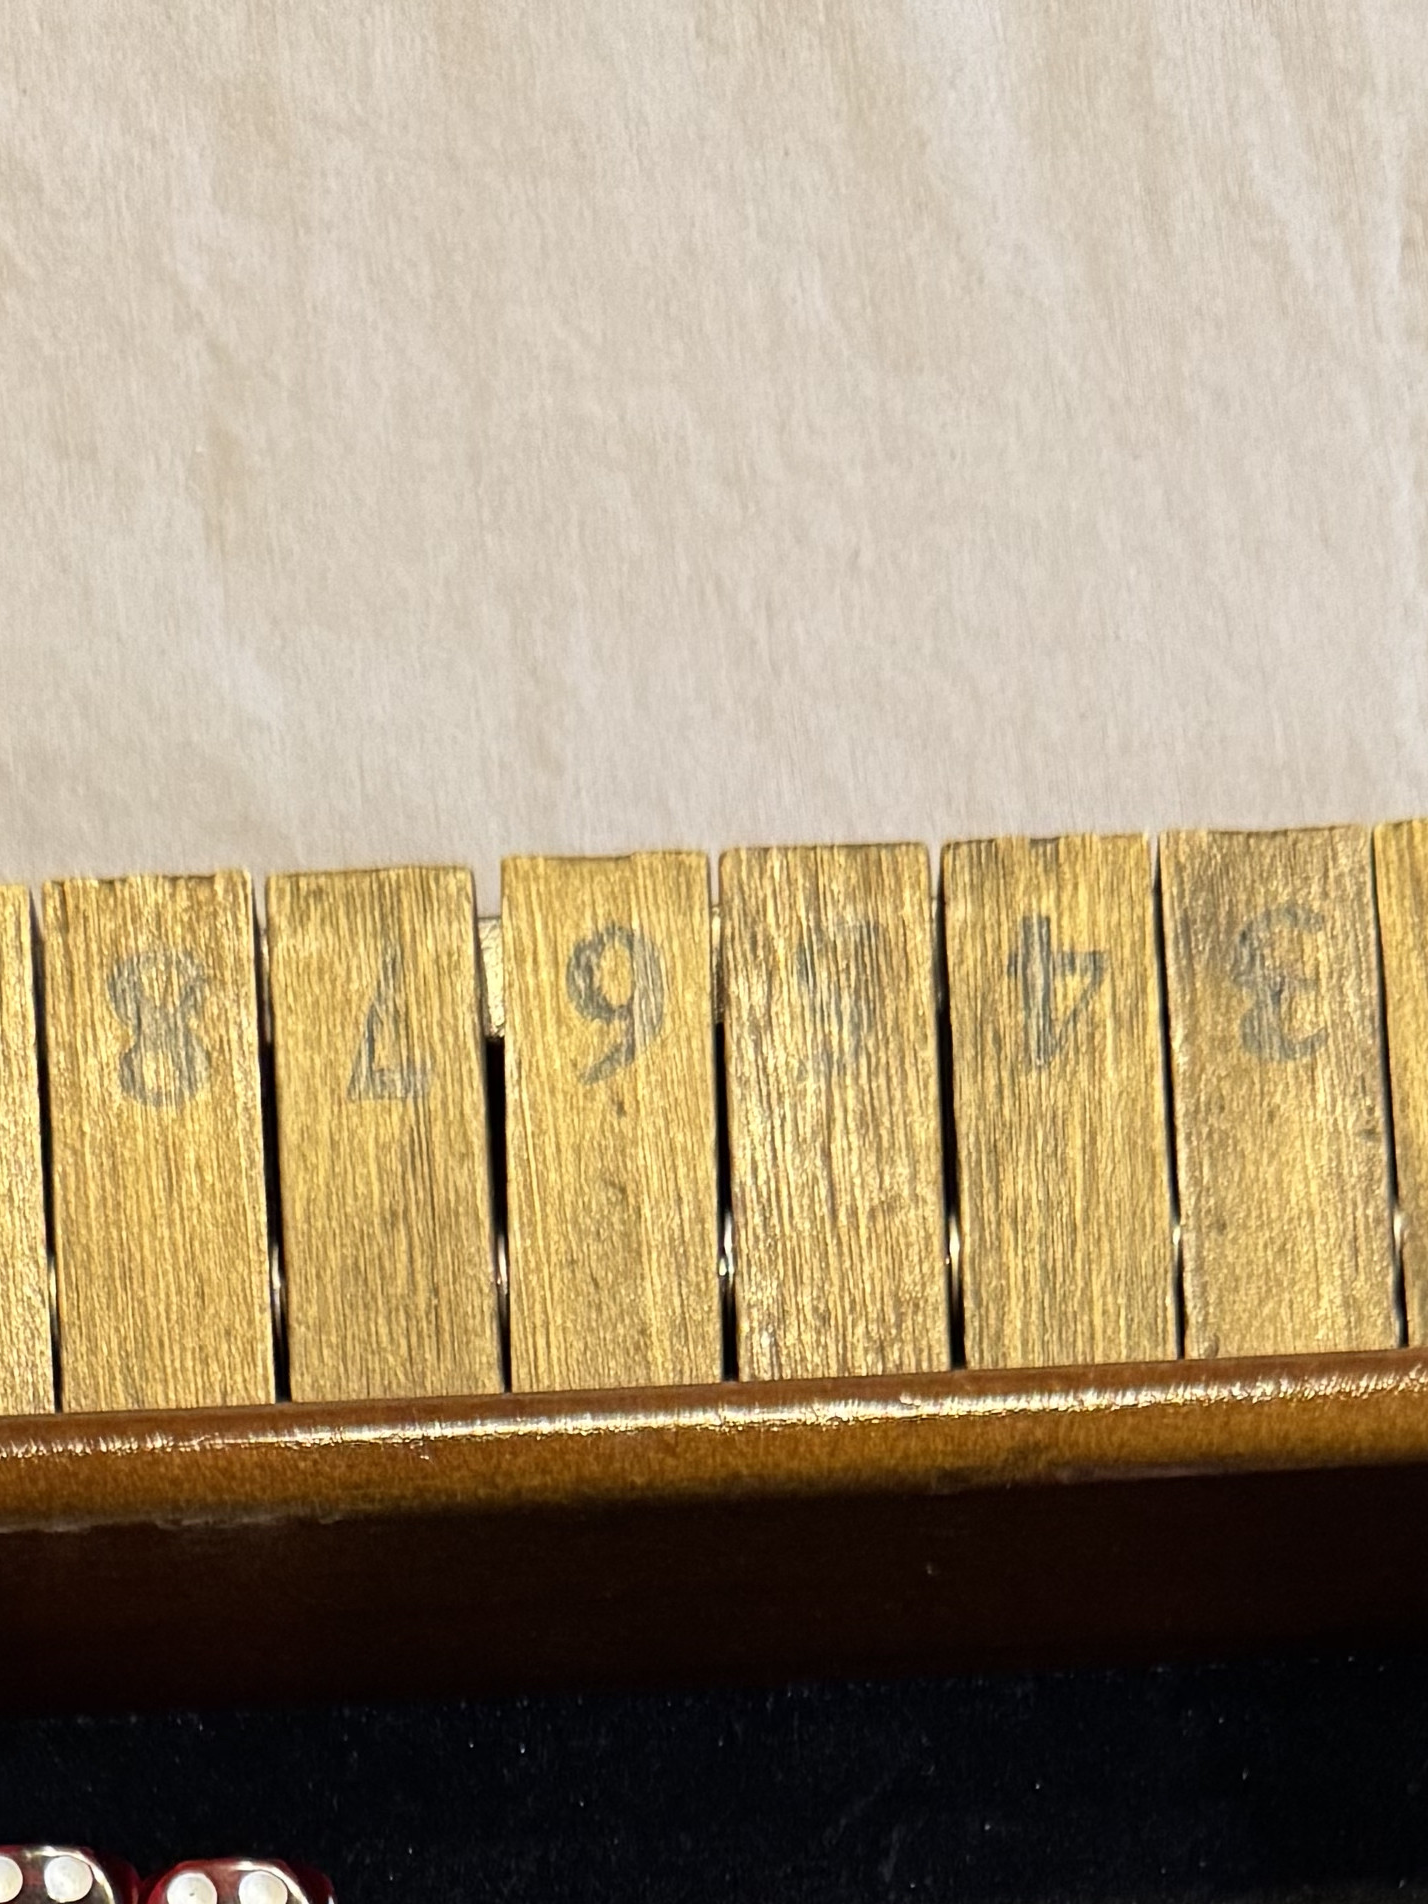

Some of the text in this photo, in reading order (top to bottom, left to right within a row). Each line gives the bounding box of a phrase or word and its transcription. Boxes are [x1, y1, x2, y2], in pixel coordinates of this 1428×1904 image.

[108, 947, 209, 1107] 8
[350, 950, 430, 1100] 7
[565, 925, 667, 1085] 6
[1009, 916, 1103, 1066] 4
[1232, 909, 1326, 1061] 3
